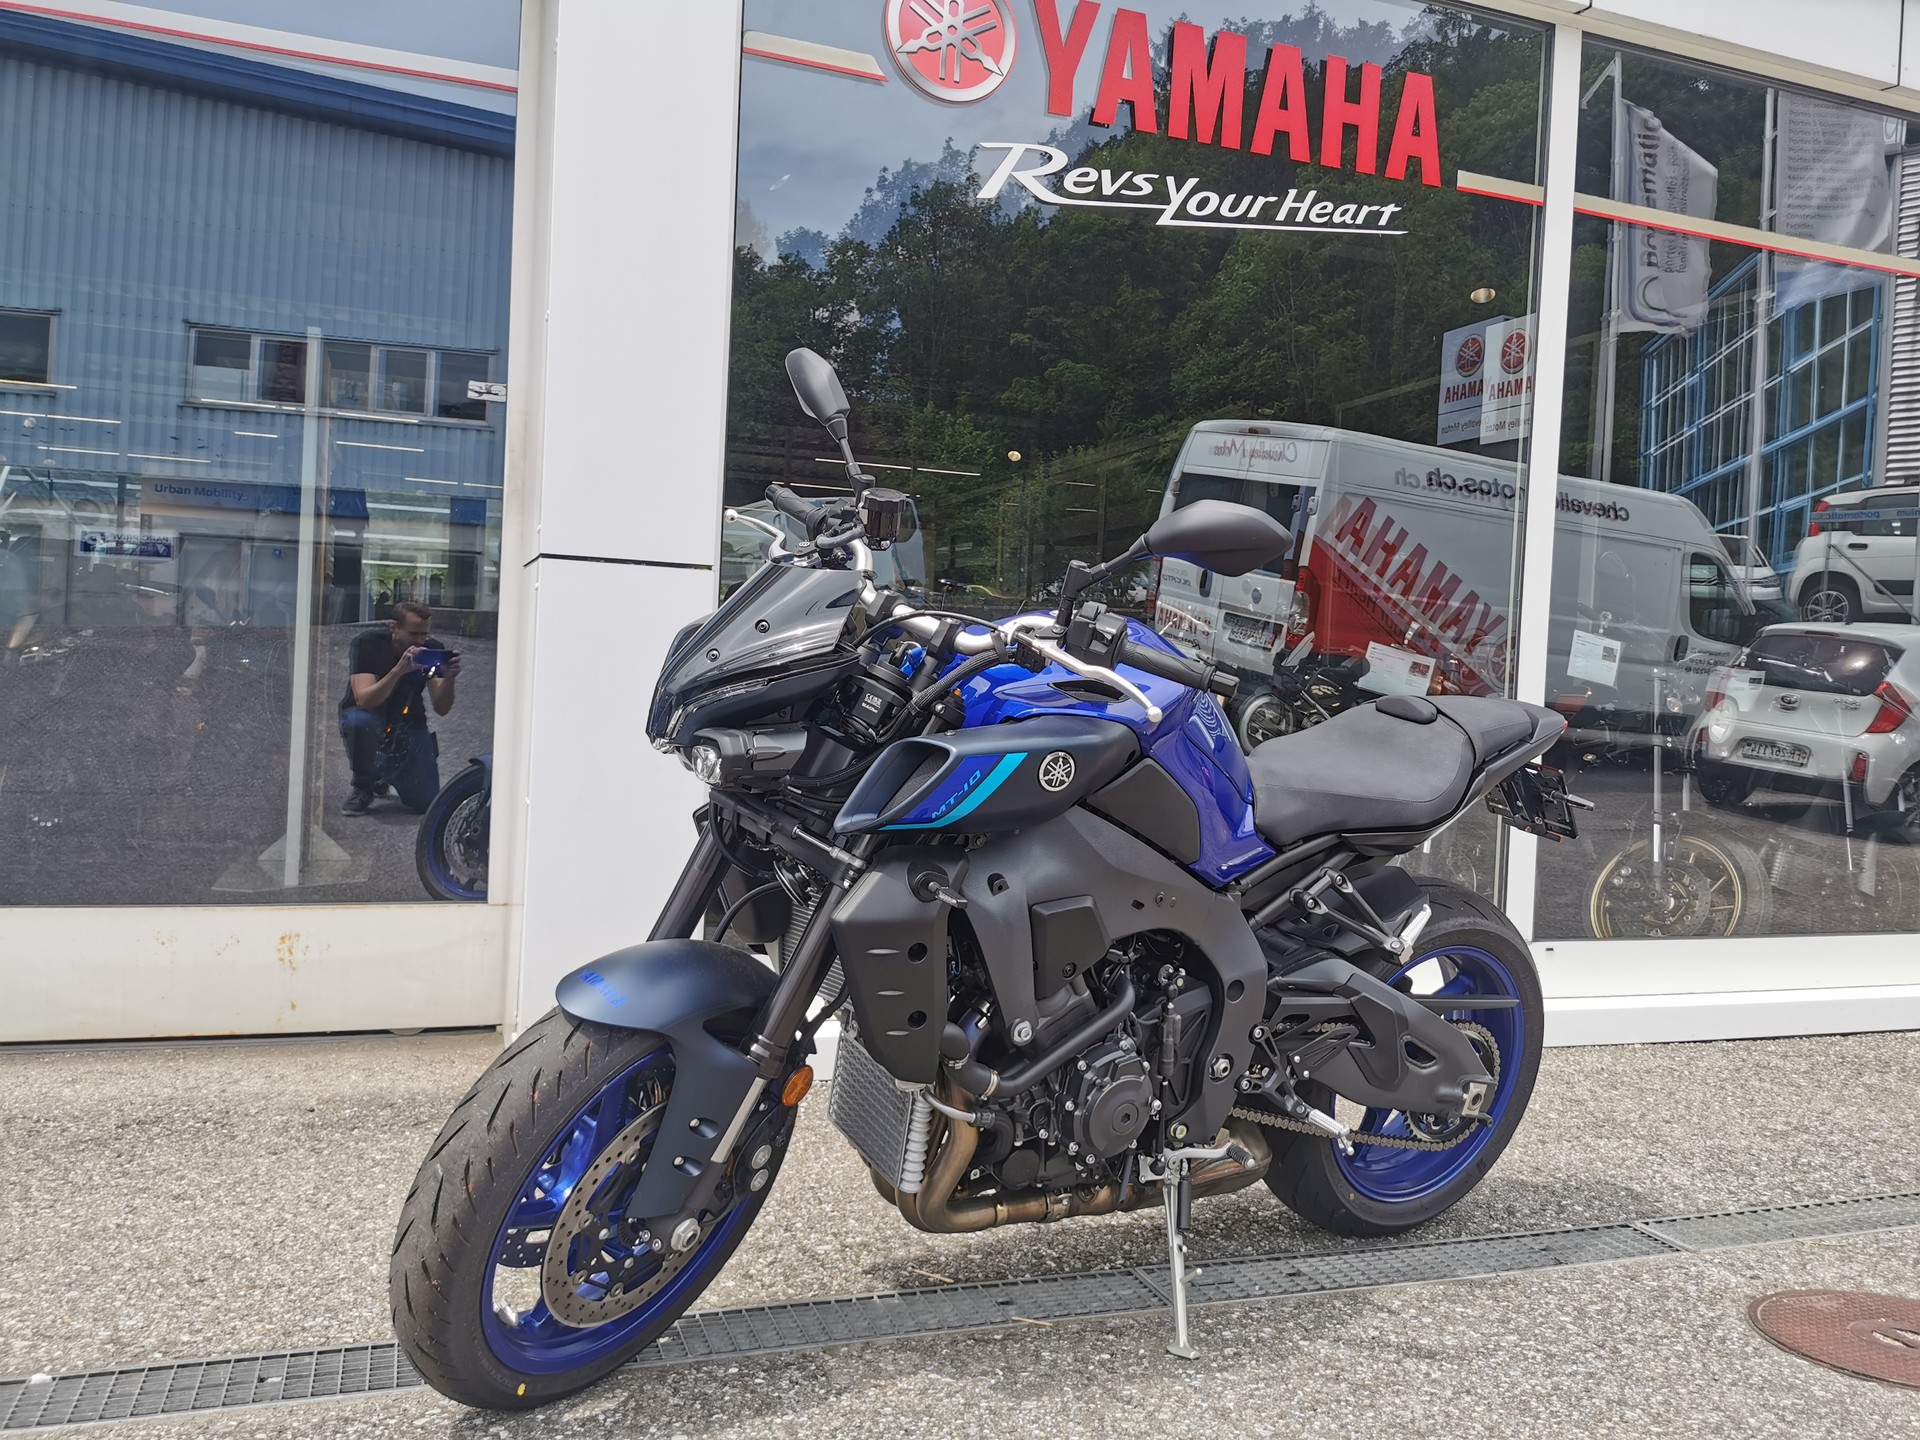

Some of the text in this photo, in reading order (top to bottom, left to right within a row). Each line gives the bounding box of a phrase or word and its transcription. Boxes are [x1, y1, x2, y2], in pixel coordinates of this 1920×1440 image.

[1034, 0, 1441, 187] YAMAHA
[976, 142, 1402, 227] Revs Your Heart
[154, 483, 244, 502] Urban Mobility
[931, 769, 982, 820] MT-10
